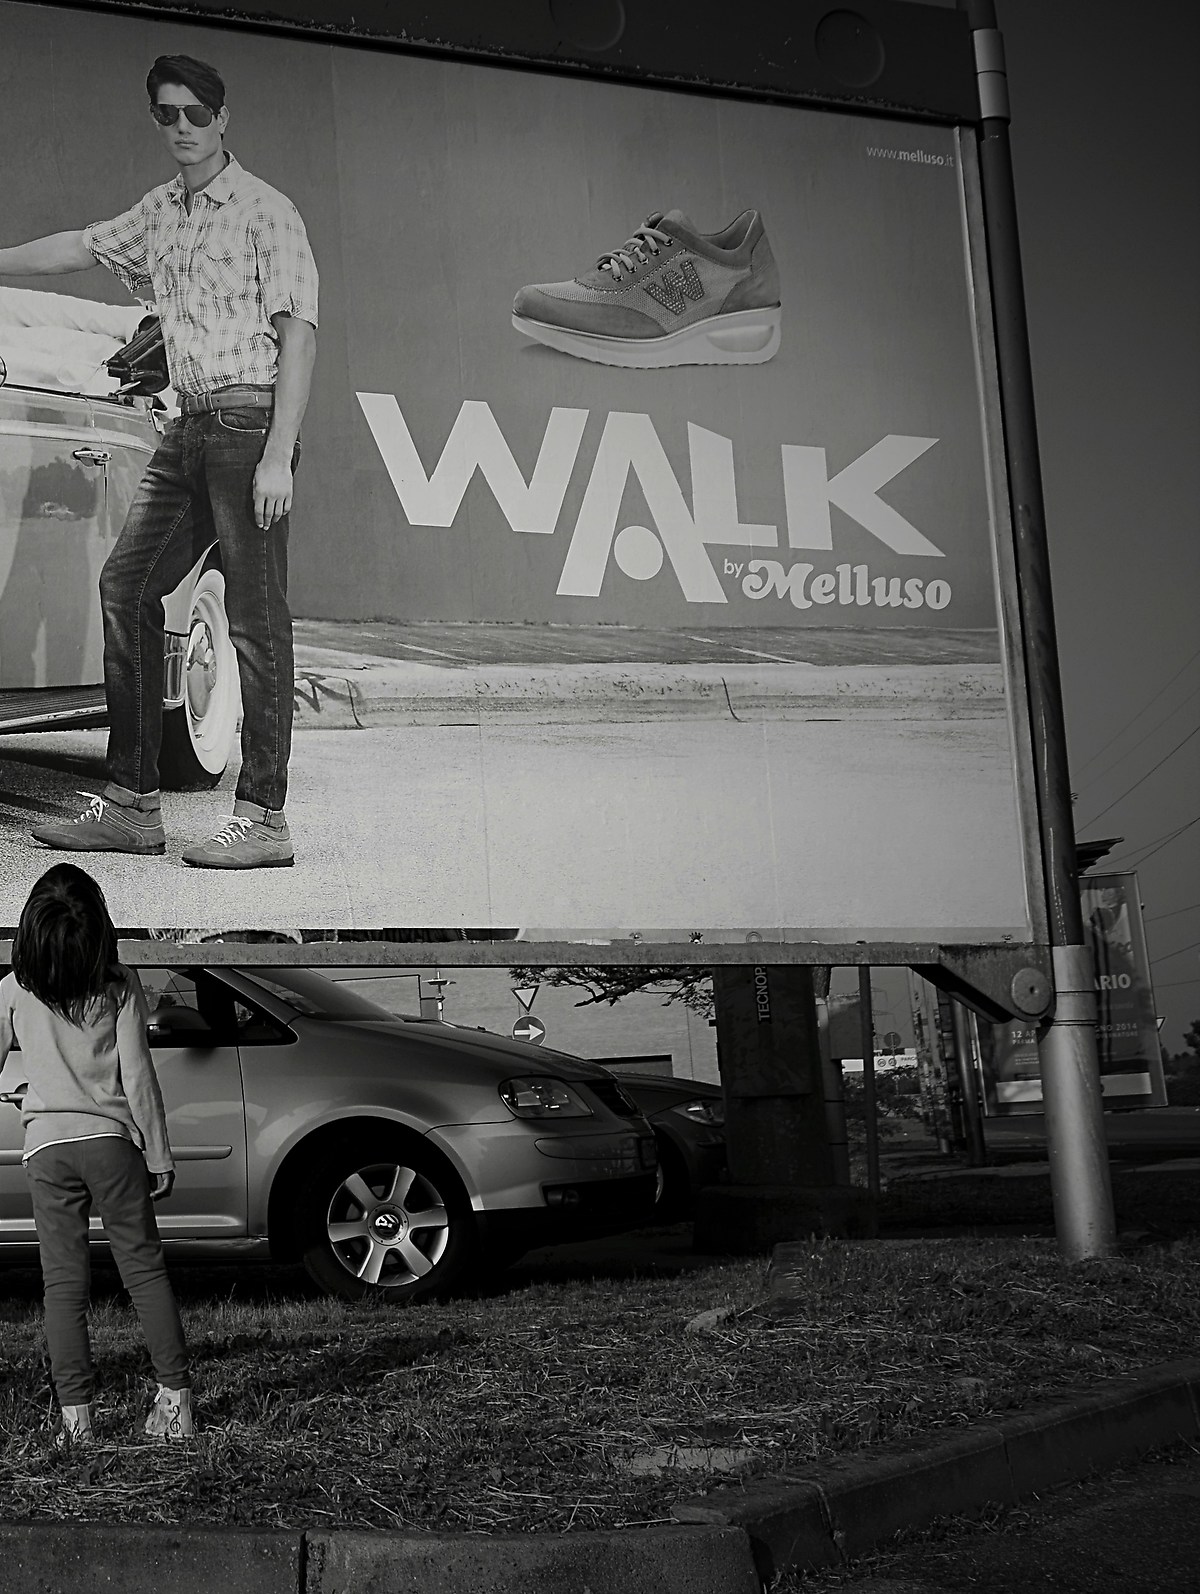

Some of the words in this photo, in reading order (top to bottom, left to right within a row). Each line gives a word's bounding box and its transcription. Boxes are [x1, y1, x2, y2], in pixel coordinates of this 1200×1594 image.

[866, 146, 955, 167] www.melluso.it
[355, 391, 947, 604] WALK
[723, 558, 744, 578] by
[741, 559, 952, 610] Melluso
[754, 966, 771, 1021] TECNOP
